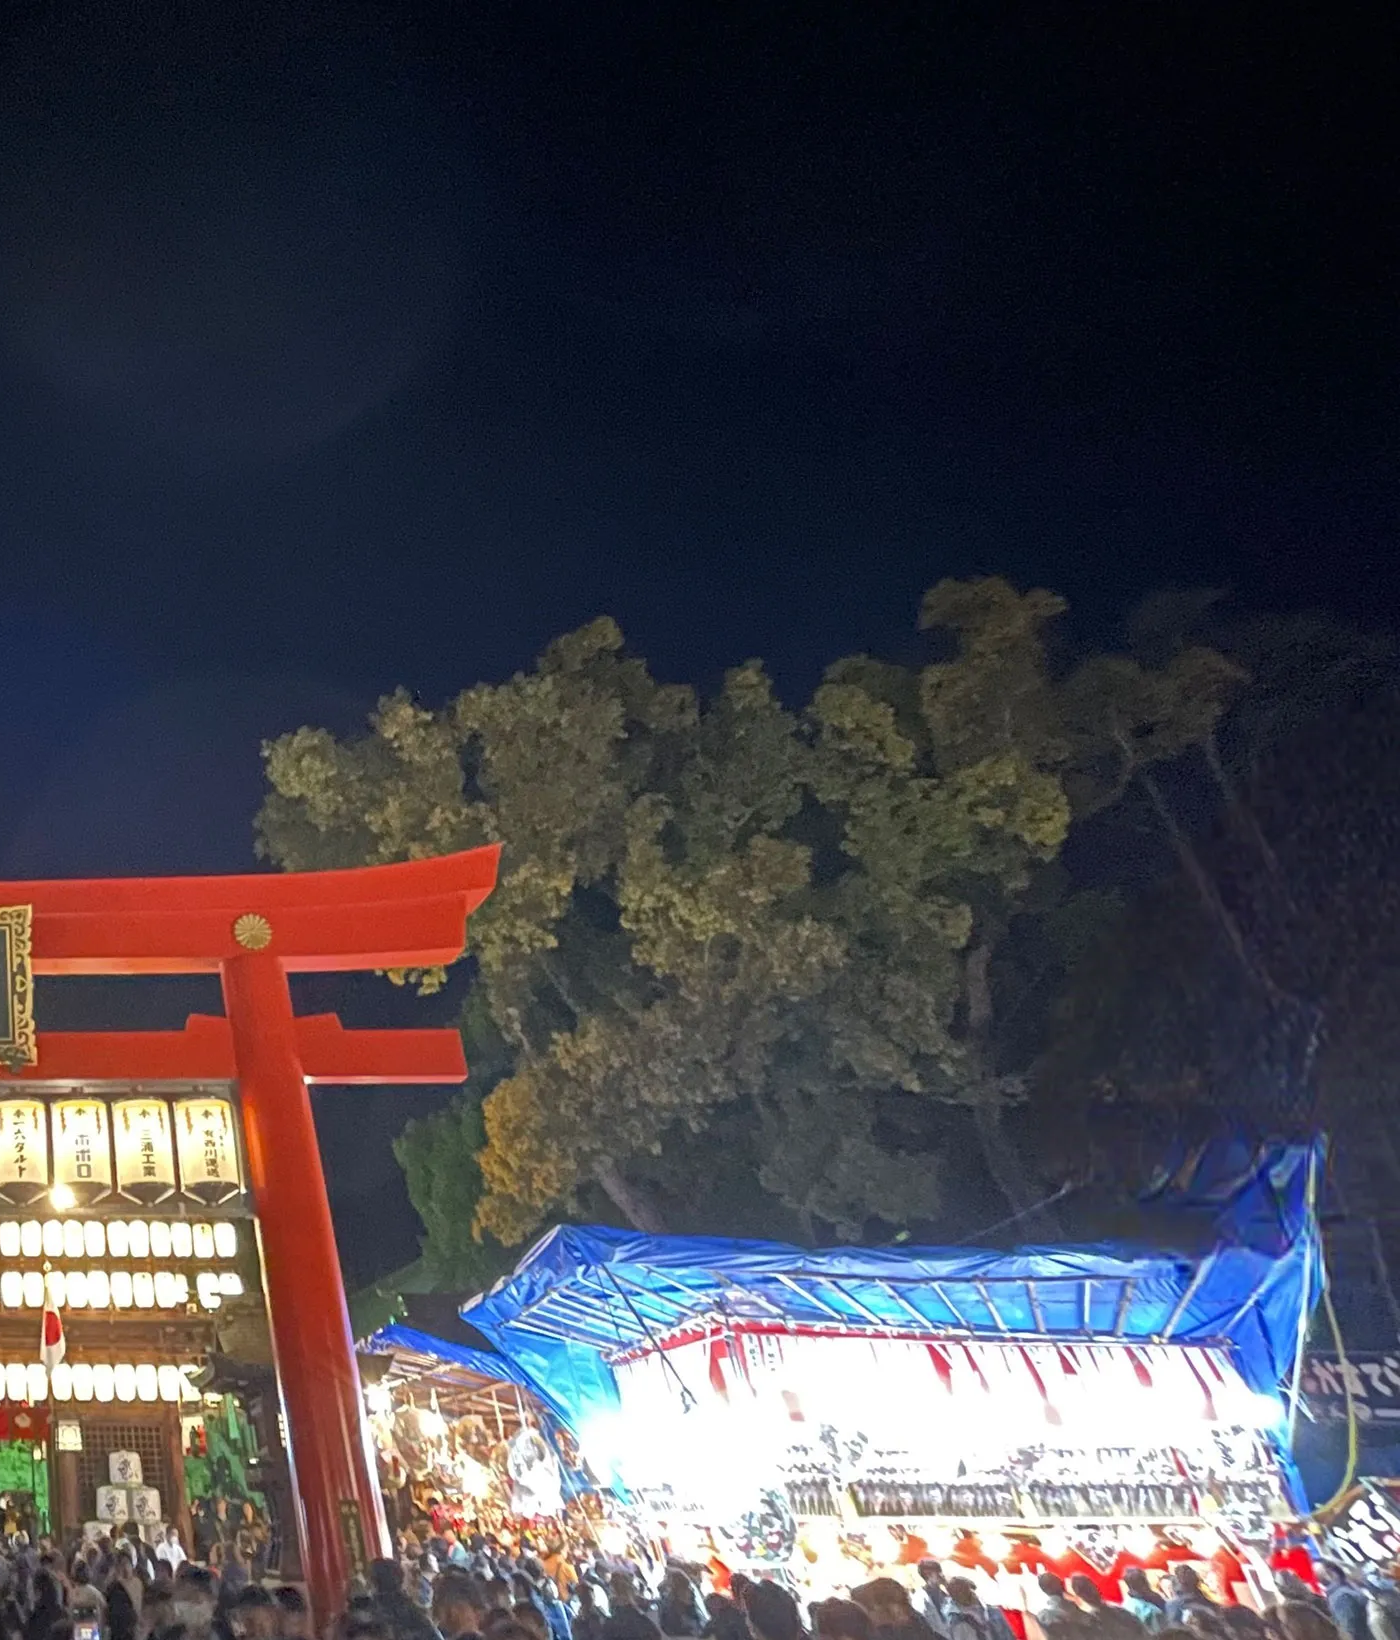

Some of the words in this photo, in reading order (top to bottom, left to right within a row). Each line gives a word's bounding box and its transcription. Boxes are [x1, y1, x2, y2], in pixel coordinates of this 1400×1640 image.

[13, 1121, 27, 1178] 一六タルト
[141, 1129, 157, 1177] 三浦工業
